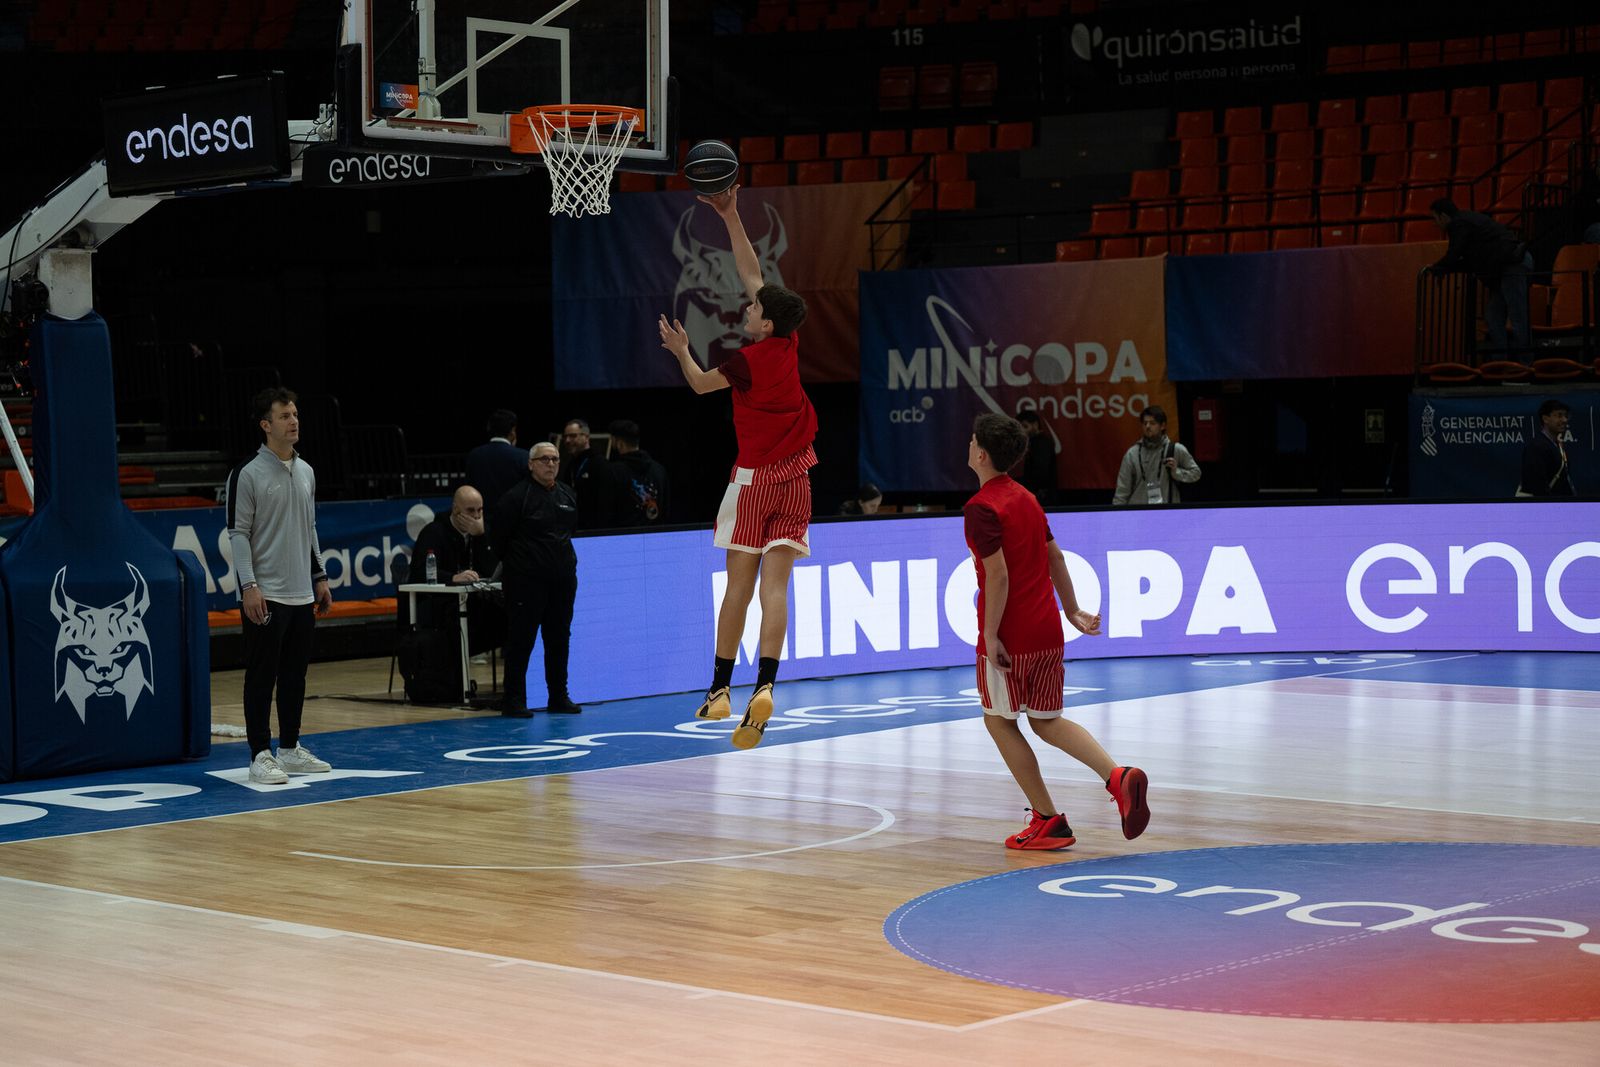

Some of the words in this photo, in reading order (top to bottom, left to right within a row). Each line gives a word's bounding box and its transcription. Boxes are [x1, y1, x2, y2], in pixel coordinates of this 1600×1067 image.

[891, 27, 925, 47] 115
[125, 112, 255, 165] endesa
[328, 153, 431, 184] endesa
[888, 403, 926, 424] acb
[1015, 388, 1150, 420] endesa
[1439, 415, 1525, 429] GENERALITAT
[1441, 431, 1525, 445] VALENCIANA
[1037, 874, 1600, 956] ende
